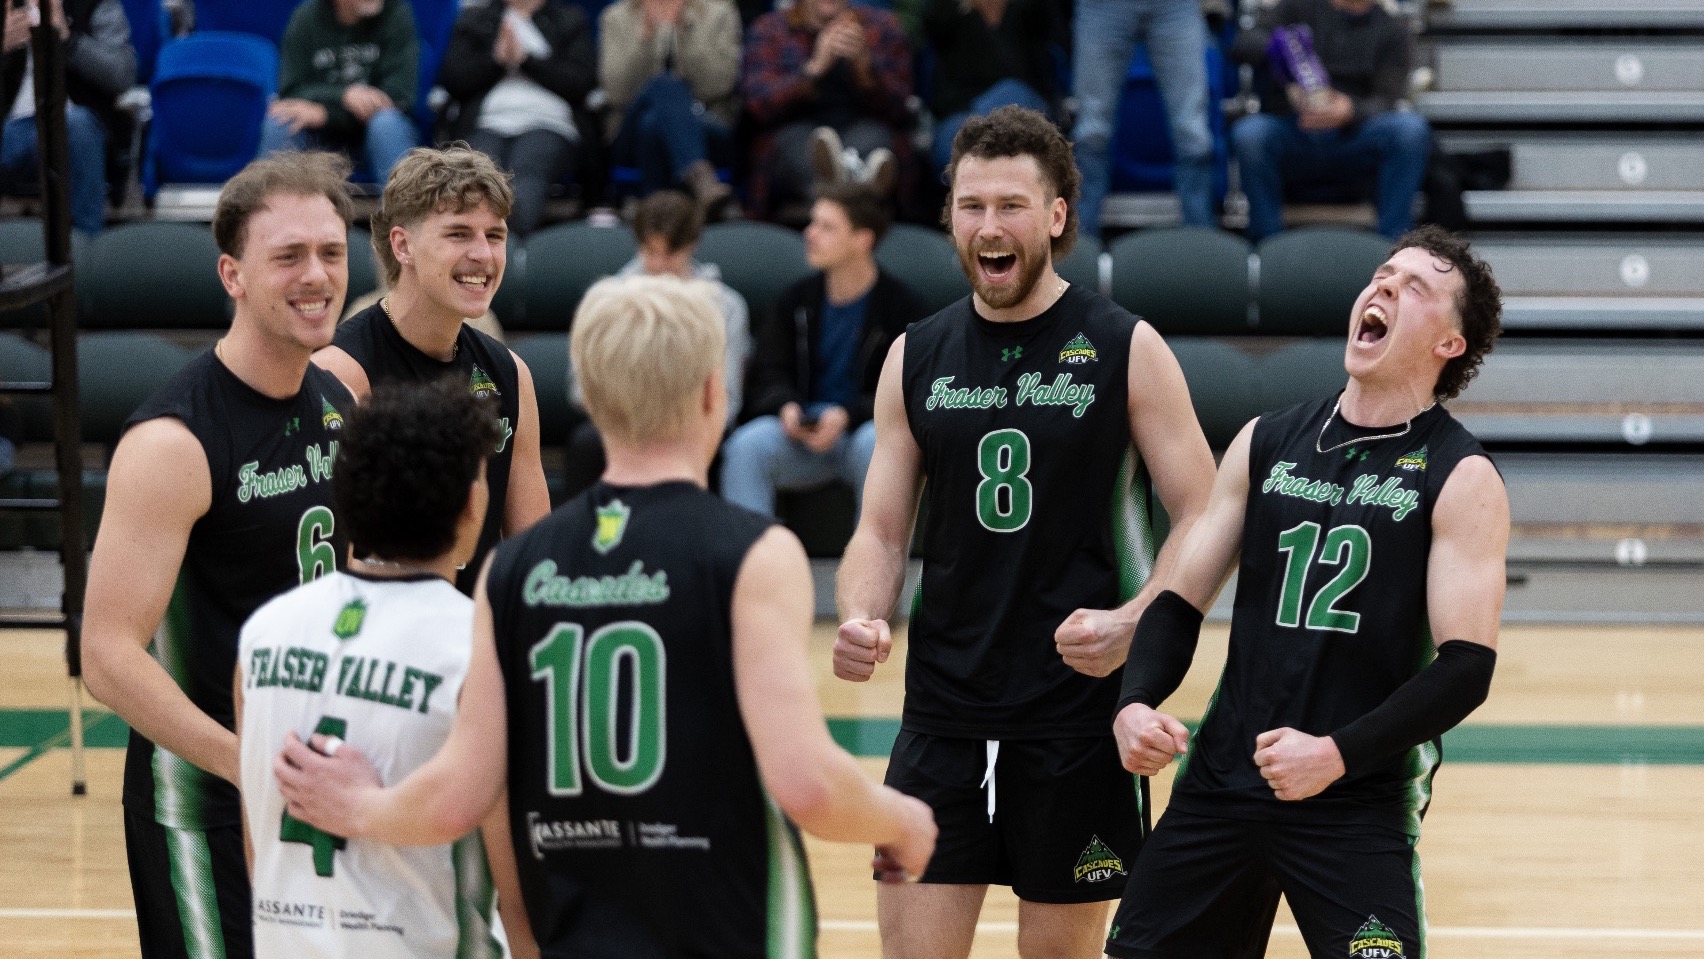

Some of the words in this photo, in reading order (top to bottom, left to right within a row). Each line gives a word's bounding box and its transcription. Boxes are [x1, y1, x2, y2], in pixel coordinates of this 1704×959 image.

[1060, 349, 1096, 360] CASCADES
[1068, 355, 1088, 363] UFV
[926, 375, 1008, 411] Fraser
[1016, 371, 1096, 418] Valley
[237, 460, 307, 503] Fraser
[976, 427, 1033, 533] 8
[1262, 460, 1345, 506] Fraser
[296, 505, 337, 587] 6
[1275, 520, 1373, 634] 12
[248, 646, 329, 693] FRASER
[336, 656, 444, 715] VALLEY
[528, 620, 667, 797] 10
[540, 818, 622, 839] ASSANTE
[1075, 859, 1122, 880] CASCADES
[1087, 868, 1111, 881] UFV
[257, 899, 325, 920] ASSANTE
[1350, 937, 1402, 955] CASCADES
[1362, 947, 1390, 958] UFV
